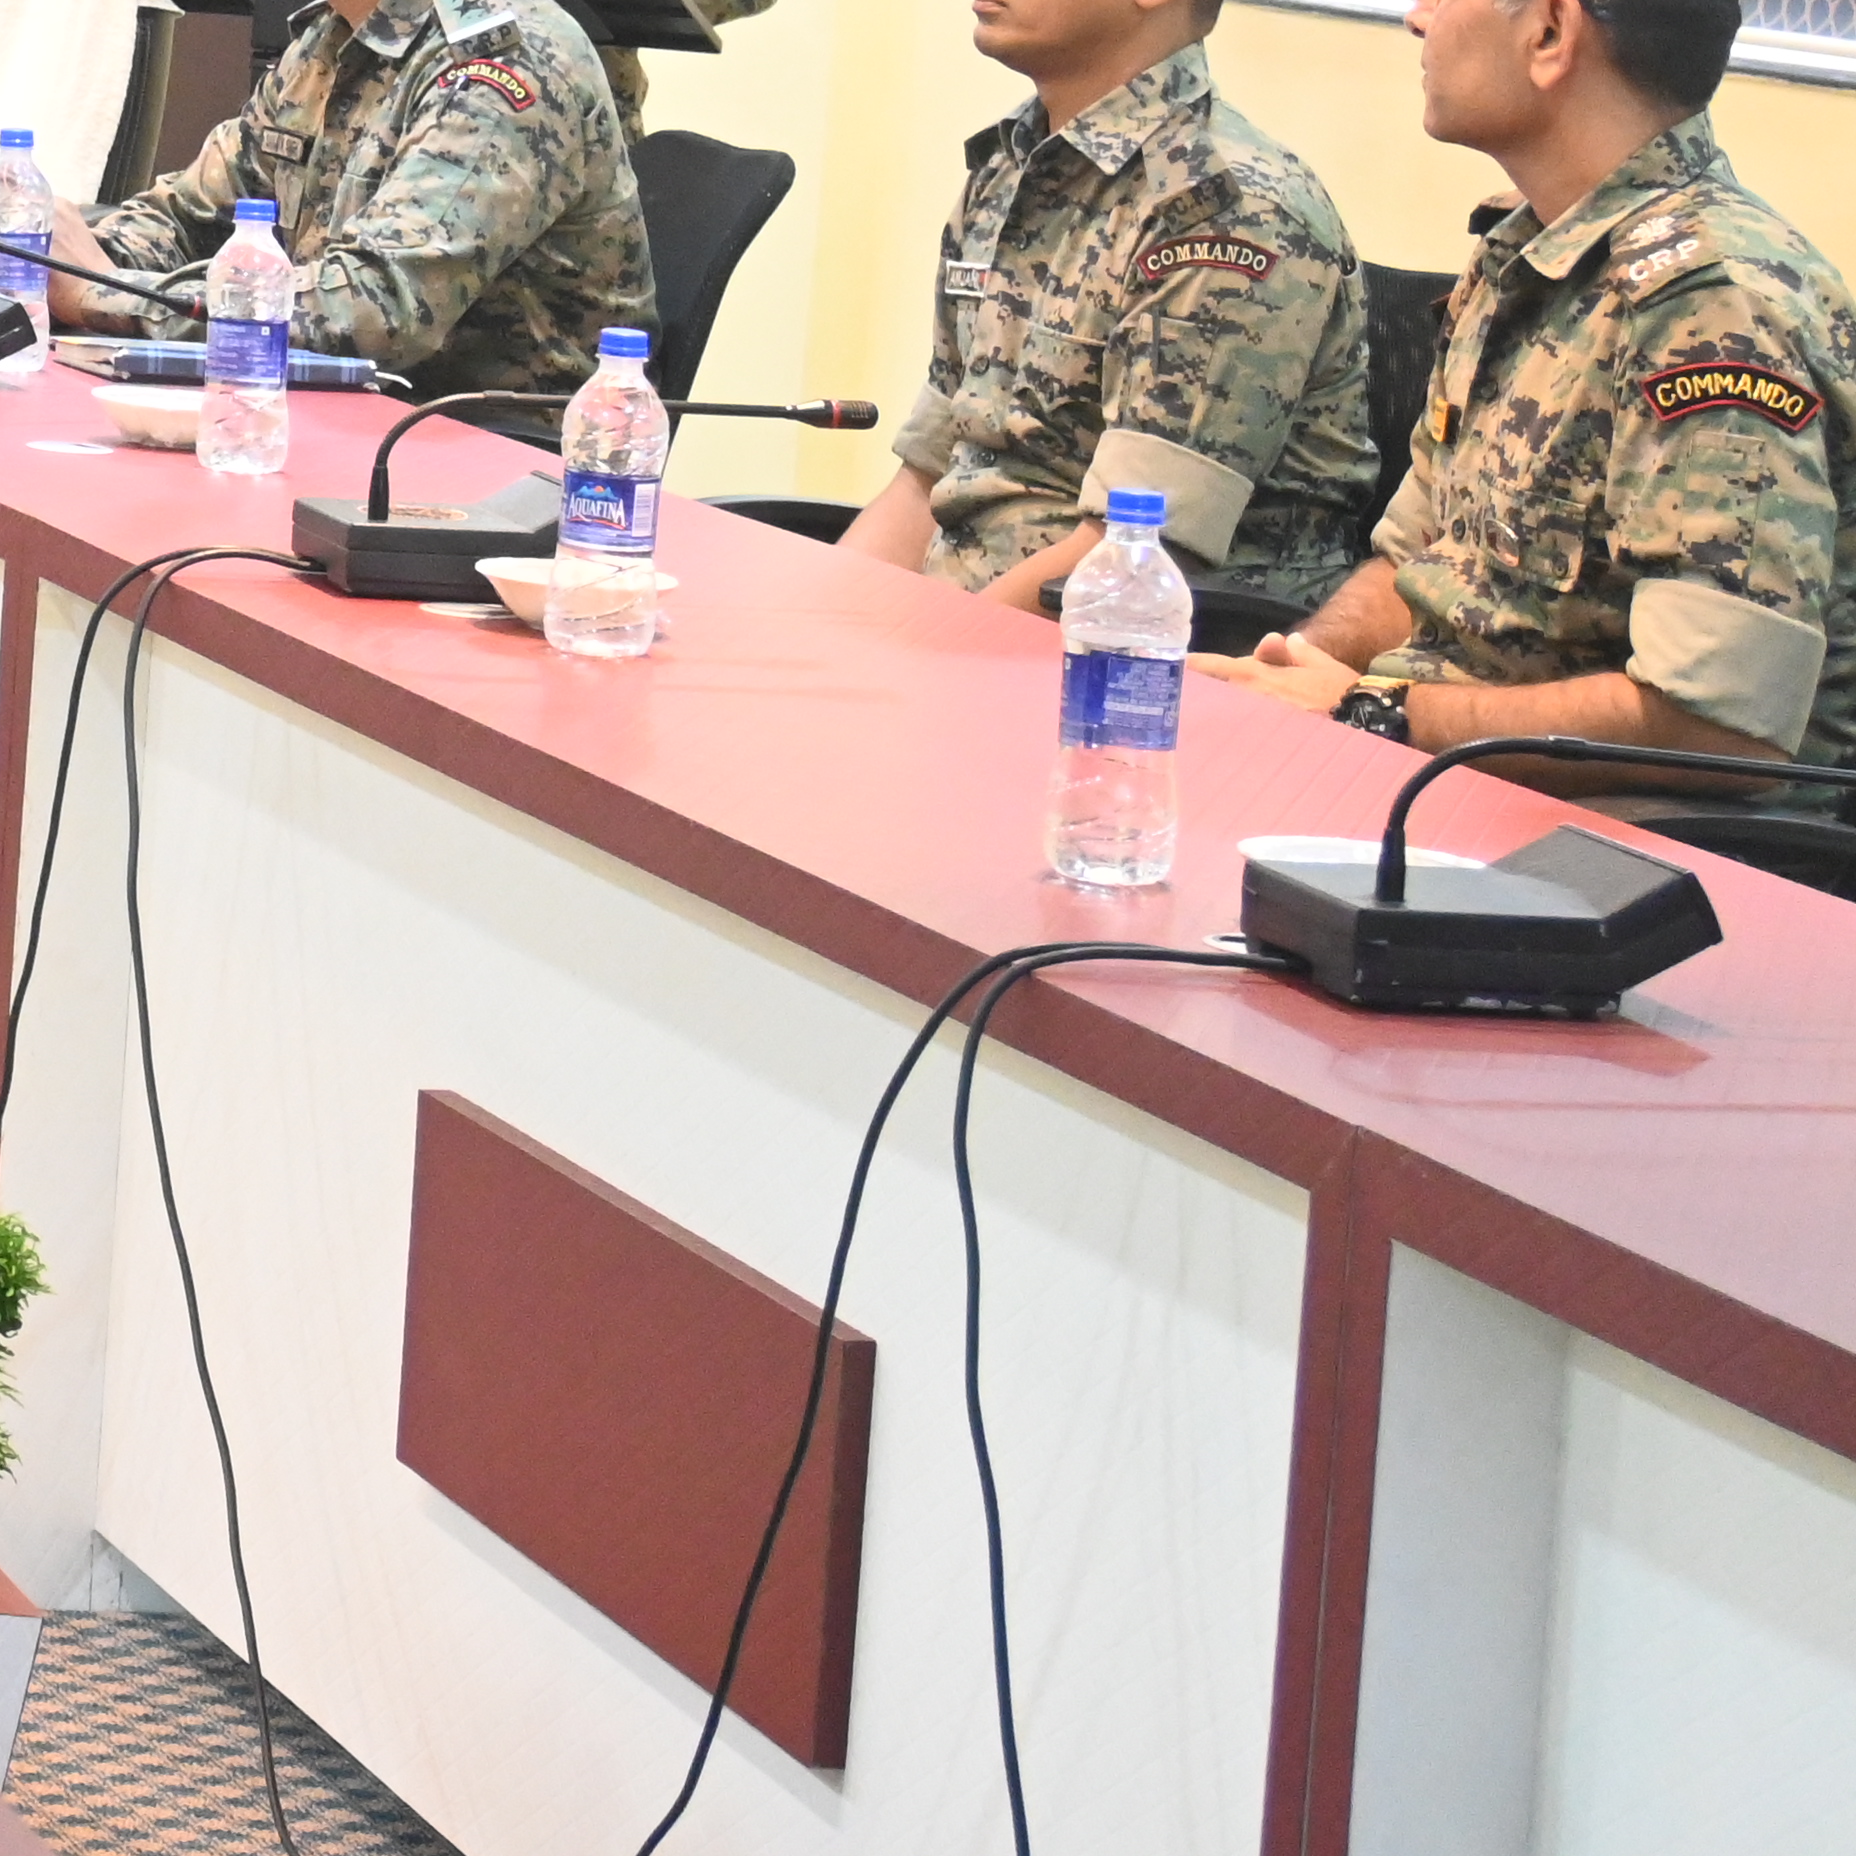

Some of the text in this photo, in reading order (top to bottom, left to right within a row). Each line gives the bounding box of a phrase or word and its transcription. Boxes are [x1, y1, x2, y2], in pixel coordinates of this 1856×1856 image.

[446, 63, 526, 100] COMMANDO
[1147, 242, 1268, 271] COMMANDO
[1628, 239, 1700, 281] CRP
[1656, 372, 1806, 418] COMMANDO
[567, 491, 626, 528] AQUAFINA
